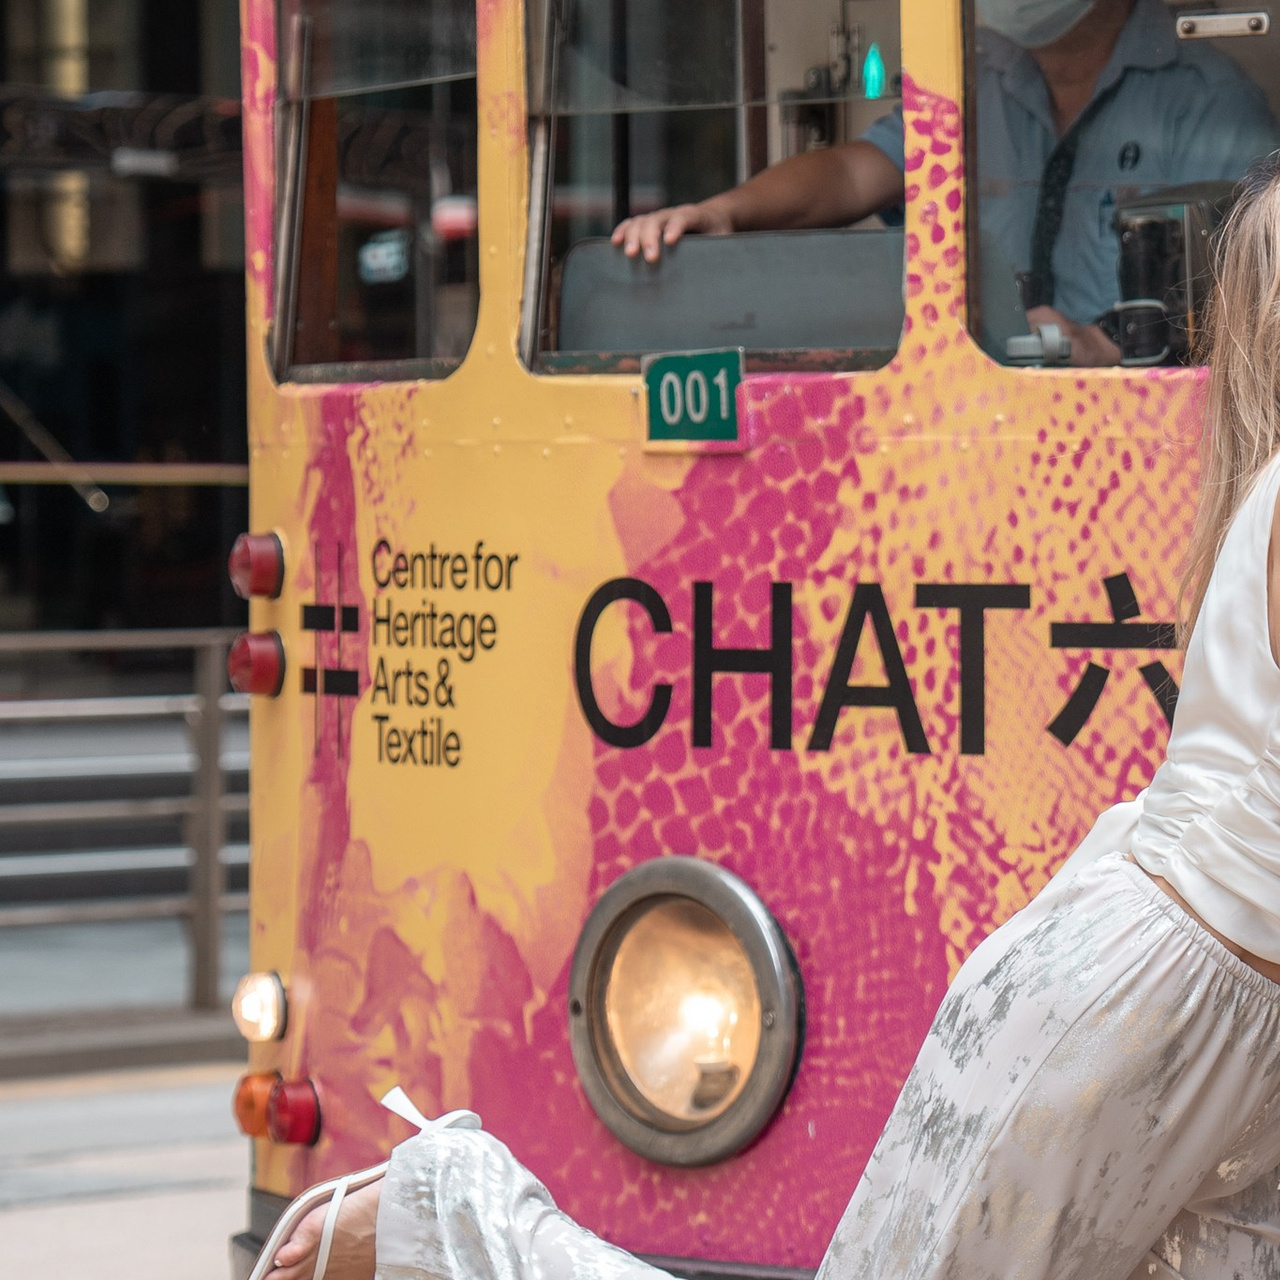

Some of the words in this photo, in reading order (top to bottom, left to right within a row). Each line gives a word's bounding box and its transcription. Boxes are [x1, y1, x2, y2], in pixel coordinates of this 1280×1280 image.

[660, 367, 729, 425] 001
[371, 538, 468, 590] Centre
[473, 539, 520, 591] for
[371, 598, 497, 662] Heritage
[370, 656, 430, 706] Arts
[433, 658, 456, 708] &
[371, 713, 461, 767] Textile
